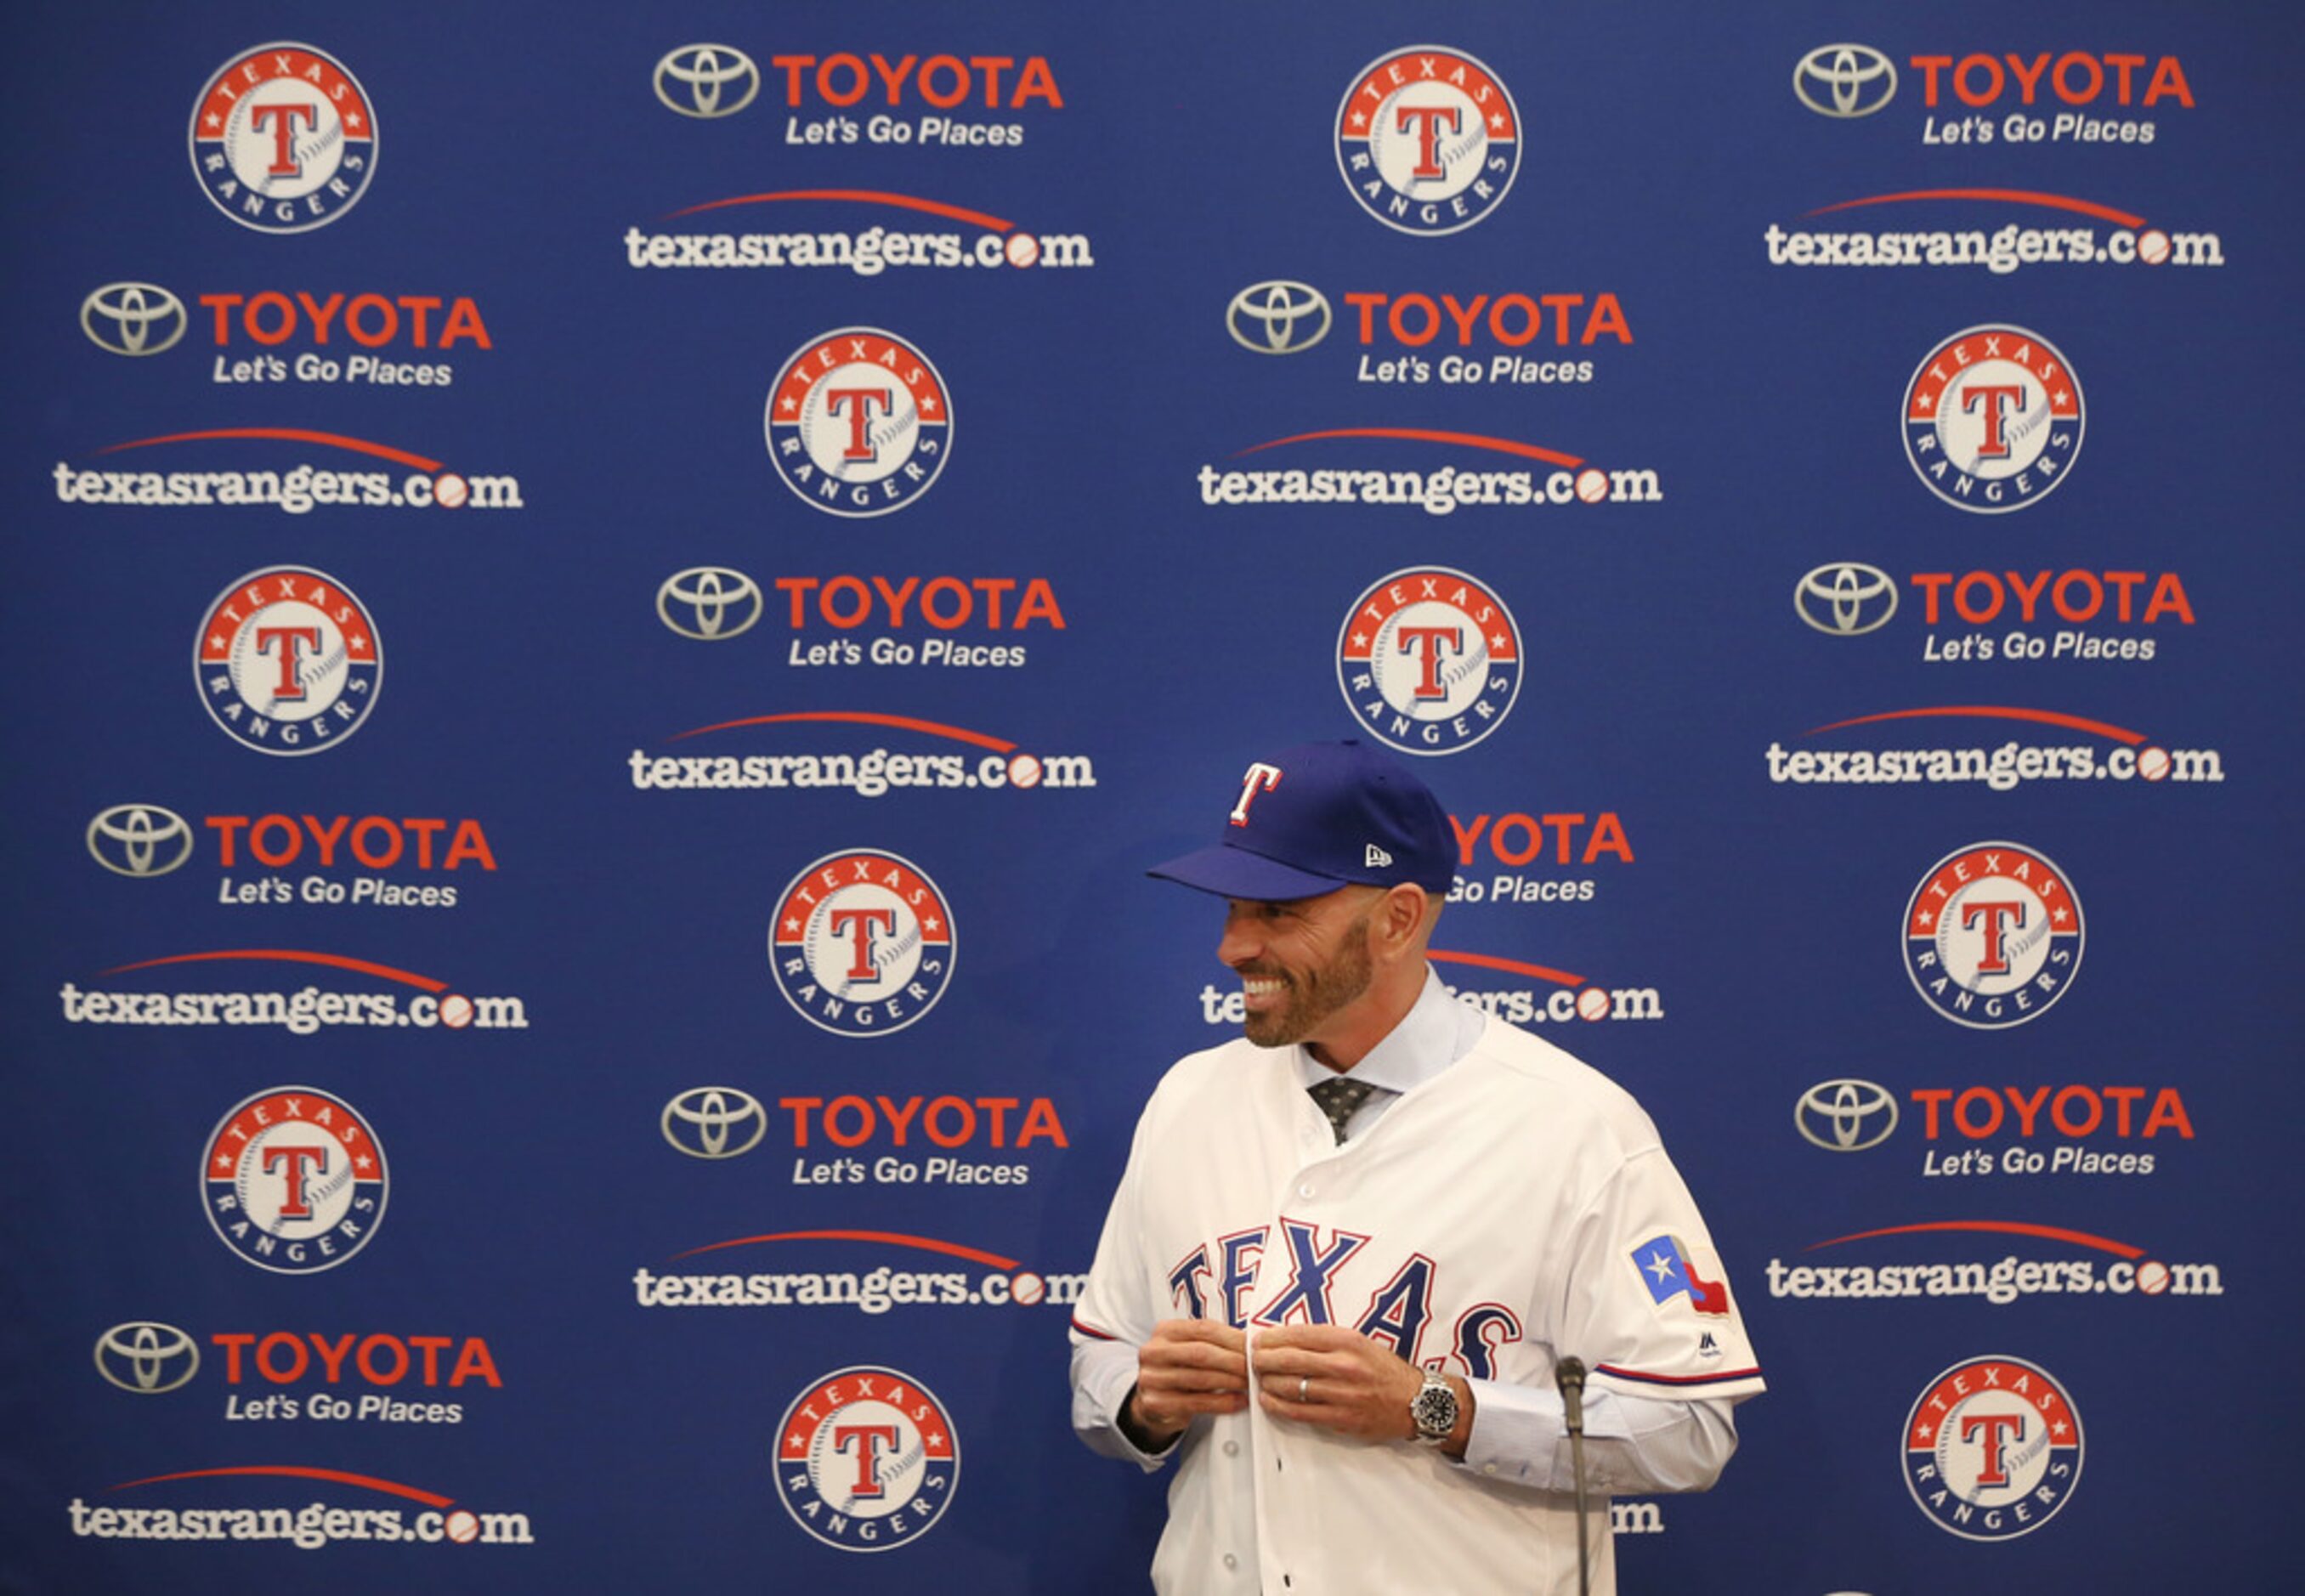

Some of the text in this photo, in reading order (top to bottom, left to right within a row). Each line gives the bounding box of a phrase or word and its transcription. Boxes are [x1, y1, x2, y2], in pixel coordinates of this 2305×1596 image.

[218, 56, 350, 101] TEXAS
[773, 54, 1062, 108] TOYOTA
[1364, 59, 1493, 105] TEXAS
[1911, 52, 2194, 106] TOYOTA
[252, 102, 319, 179] T
[785, 115, 1023, 145] Let's Go Places
[1396, 105, 1463, 182] T
[1923, 114, 2155, 144] Let's Go Places
[205, 153, 363, 221] RANGERS
[1351, 156, 1506, 224] RANGERS
[625, 227, 1093, 274] texasrangers.com
[1764, 224, 2223, 273] texasrangers.com
[201, 292, 490, 348] TOYOTA
[1345, 293, 1632, 346] TOYOTA
[213, 354, 451, 386] Let's Go Places
[795, 341, 925, 386] TEXAS
[1358, 354, 1594, 383] Let's Go Places
[1930, 338, 2058, 382] TEXAS
[827, 387, 894, 463] T
[1962, 383, 2027, 459] T
[54, 463, 523, 513] texasrangers.com
[781, 437, 937, 505] RANGERS
[1198, 466, 1662, 514] texasrangers.com
[1917, 433, 2070, 501] RANGERS
[224, 580, 354, 625] TEXAS
[776, 576, 1065, 629] TOYOTA
[1366, 580, 1495, 625] TEXAS
[1911, 569, 2195, 623] TOYOTA
[257, 625, 323, 702] T
[789, 637, 1025, 667] Let's Go Places
[1398, 625, 1464, 702] T
[1923, 631, 2155, 661] Let's Go Places
[210, 676, 367, 744] RANGERS
[1352, 676, 1508, 744] RANGERS
[629, 750, 1096, 796] texasrangers.com
[1766, 743, 2223, 790] texasrangers.com
[1230, 762, 1283, 828] T
[207, 815, 496, 869] TOYOTA
[1447, 812, 1634, 867] YOTA
[219, 876, 456, 907] Let's Go Places
[798, 863, 928, 907] TEXAS
[1491, 875, 1595, 903] Places
[1931, 855, 2057, 900] TEXAS
[830, 908, 898, 983] T
[1962, 901, 2027, 976] T
[61, 984, 528, 1033] texasrangers.com
[784, 958, 941, 1024] RANGERS
[1917, 950, 2070, 1016] RANGERS
[230, 1100, 360, 1145] TEXAS
[780, 1095, 1068, 1147] TOYOTA
[1912, 1085, 2193, 1139] TOYOTA
[263, 1146, 330, 1220] T
[793, 1157, 1028, 1185] Let's Go Places
[1923, 1146, 2154, 1176] Let's Go Places
[217, 1195, 373, 1261] RANGERS
[634, 1267, 1090, 1313] texasrangers.com
[1766, 1257, 2223, 1303] texasrangers.com
[213, 1333, 501, 1387] TOYOTA
[226, 1394, 462, 1423] Let's Go Places
[801, 1379, 932, 1423] TEXAS
[1930, 1368, 2056, 1412] TEXAS
[835, 1424, 900, 1499] T
[1962, 1413, 2026, 1488] T
[789, 1474, 943, 1540] RANGERS
[1917, 1463, 2069, 1529] RANGERS
[70, 1499, 533, 1548] texasrangers.com
